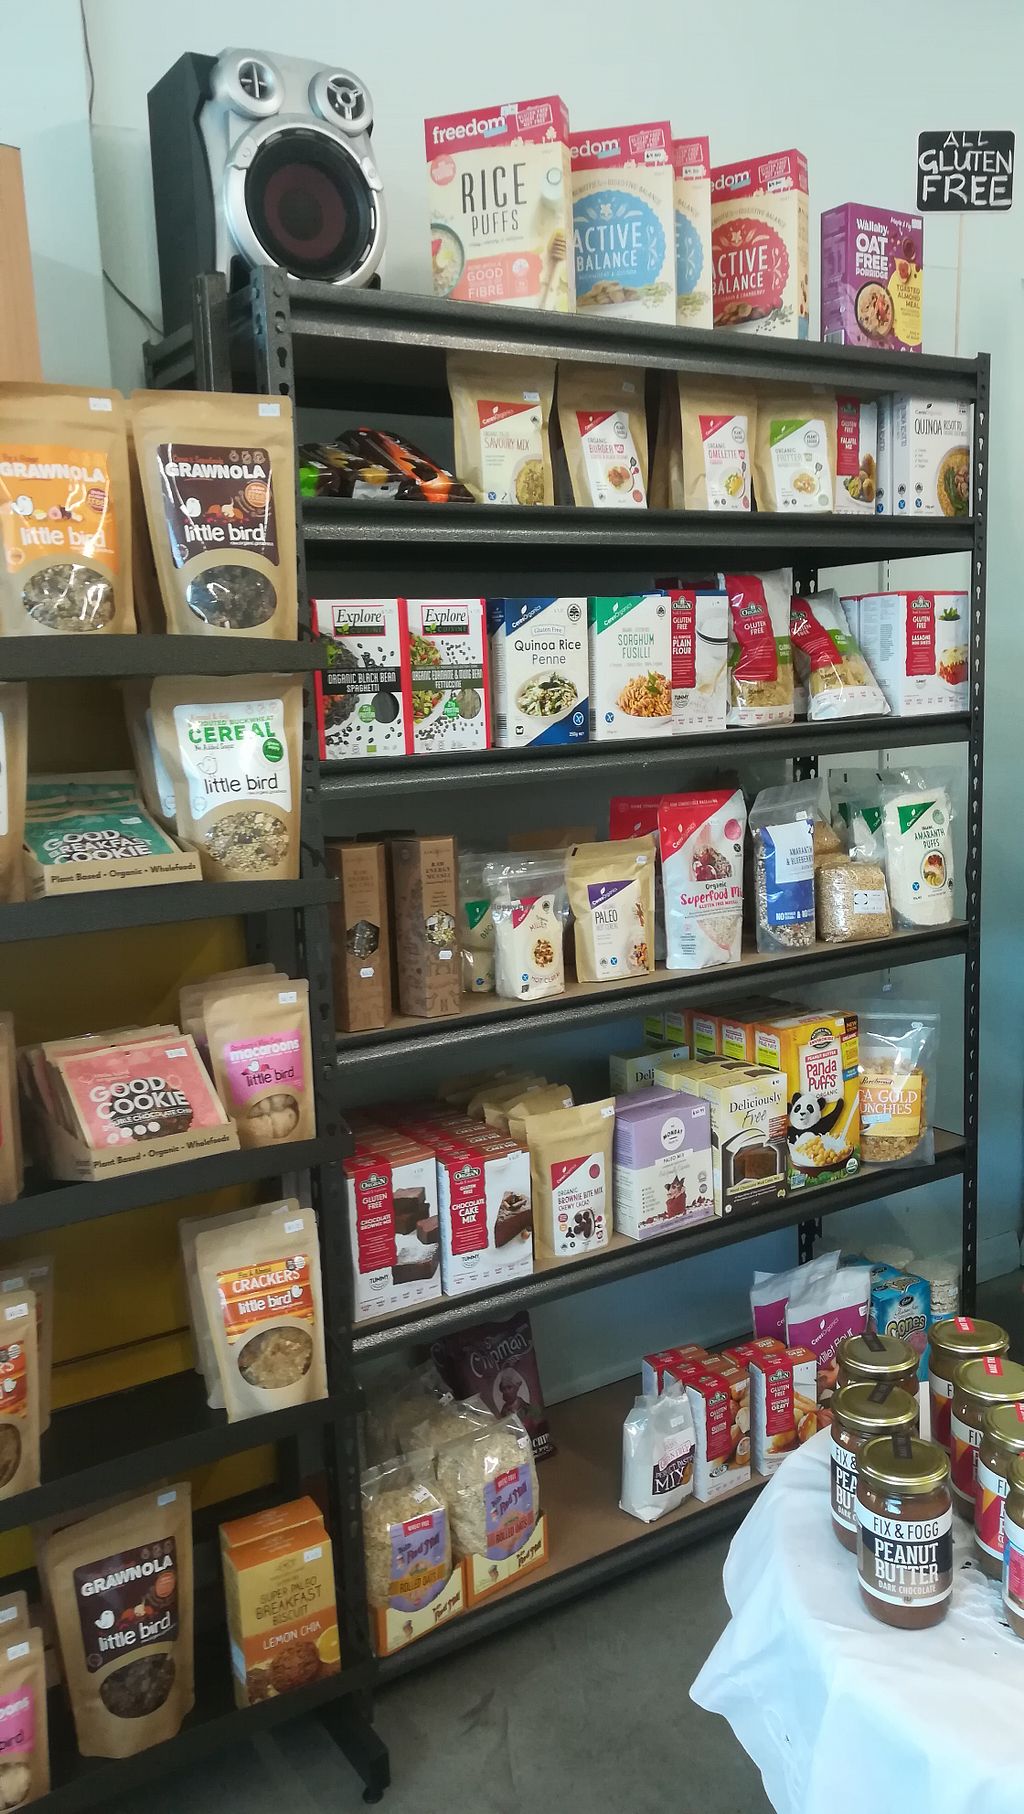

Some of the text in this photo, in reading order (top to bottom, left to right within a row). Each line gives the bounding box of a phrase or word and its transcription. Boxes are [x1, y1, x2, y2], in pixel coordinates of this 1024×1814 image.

[432, 115, 506, 145] freedom
[943, 131, 989, 148] ALL
[571, 138, 620, 159] edom
[919, 149, 1014, 176] GLUTEN
[461, 162, 527, 214] RICE
[921, 174, 1012, 206] FREE
[472, 209, 519, 237] PUFFS
[857, 218, 888, 236] Wallaby
[574, 222, 643, 254] ACTIVE
[856, 233, 888, 255] OAT
[577, 250, 638, 273] BALANCE
[856, 252, 888, 271] FREE
[467, 267, 503, 281] GOOD
[856, 267, 888, 280] PORRIDGE
[468, 283, 504, 299] FIBRE
[712, 271, 764, 296] BALANCE
[896, 284, 920, 296] TOASTED
[897, 292, 920, 302] ALMOND
[905, 301, 920, 310] MEAL
[915, 419, 943, 436] QUINOA
[485, 437, 530, 450] SAVOURY MIX
[0, 462, 106, 484] GRAWNOLA
[164, 462, 267, 479] GRAWNOLA
[20, 526, 65, 546] little
[184, 523, 266, 543] little bird
[336, 608, 382, 626] Explore
[424, 608, 467, 626] Explore
[672, 616, 692, 624] GLUTEN
[744, 621, 766, 630] GLUTEN
[618, 634, 655, 647] SORGHUM
[750, 627, 765, 636] FREE
[514, 638, 582, 652] Quinoa Rice
[672, 639, 692, 647] PLAIN
[672, 647, 692, 655] FLOUR
[531, 653, 566, 665] Penne
[622, 646, 651, 660] FUSILLI
[328, 671, 397, 684] ORGANIC BLACK BEAN
[346, 683, 380, 693] SPAGHETTI
[188, 721, 276, 743] CEREAL
[204, 772, 279, 795] little bird
[43, 829, 120, 851] GOOD
[914, 828, 946, 841] AMARANTH
[923, 838, 940, 849] PUFFS
[48, 837, 152, 858] BREAKFAST
[54, 845, 153, 865] COOKIE
[789, 845, 813, 855] AMARANTH
[51, 863, 196, 883] Plant Based Organic Wholefoods
[705, 881, 727, 891] Organic
[680, 889, 729, 908] Superfood
[594, 908, 618, 924] PALEO
[776, 912, 785, 921] NO
[229, 1039, 300, 1062] macaroons
[246, 1065, 295, 1087] little bird
[806, 1059, 838, 1079] Panda
[89, 1076, 166, 1103] GOOD
[815, 1088, 838, 1099] ORGANIC
[878, 1089, 918, 1104] GOLD
[96, 1091, 192, 1120] COOKIE
[729, 1091, 782, 1113] Deliciously
[133, 1110, 176, 1122] CHOCOLATE
[741, 1108, 767, 1129] Free
[662, 1129, 683, 1140] MONDAY
[93, 1134, 230, 1168] Plant Based Organic Wholefoods
[362, 1192, 388, 1205] GLUTEN
[557, 1187, 578, 1197] ORGANIC
[558, 1186, 604, 1205] BROWNIE BITE MIX
[368, 1202, 383, 1211] FREE
[451, 1198, 485, 1211] CHOCOLATE
[458, 1207, 479, 1217] CAKE
[558, 1203, 575, 1212] CHEWY
[360, 1213, 391, 1226] CHOCOLATE
[462, 1215, 477, 1225] MIX
[231, 1268, 301, 1294] CRACKERS
[238, 1290, 292, 1315] little bird
[886, 1314, 926, 1338] Cones
[469, 1332, 529, 1379] Chipman
[816, 1344, 836, 1367] Millet
[770, 1384, 790, 1394] GLUTEN
[771, 1403, 790, 1411] GRAVY
[835, 1446, 857, 1471] FIX &
[655, 1466, 685, 1493] MIX
[835, 1465, 858, 1492] PEA
[836, 1486, 857, 1511] BUT
[496, 1518, 528, 1544] ROLLED OATS
[873, 1518, 940, 1540] FIX & FOGG
[874, 1537, 940, 1565] PEANUT
[79, 1553, 174, 1598] GRAWNOLA
[399, 1571, 437, 1593] ROLLED OATS
[874, 1560, 940, 1586] BUTTER
[259, 1575, 318, 1606] SUPER PALEO
[877, 1580, 937, 1595] DARK CHOCOLATE
[255, 1583, 323, 1620] BREAKFAST
[272, 1604, 309, 1626] BISCUIT
[98, 1611, 173, 1653] little bird
[263, 1620, 323, 1651] LEMON CHIA
